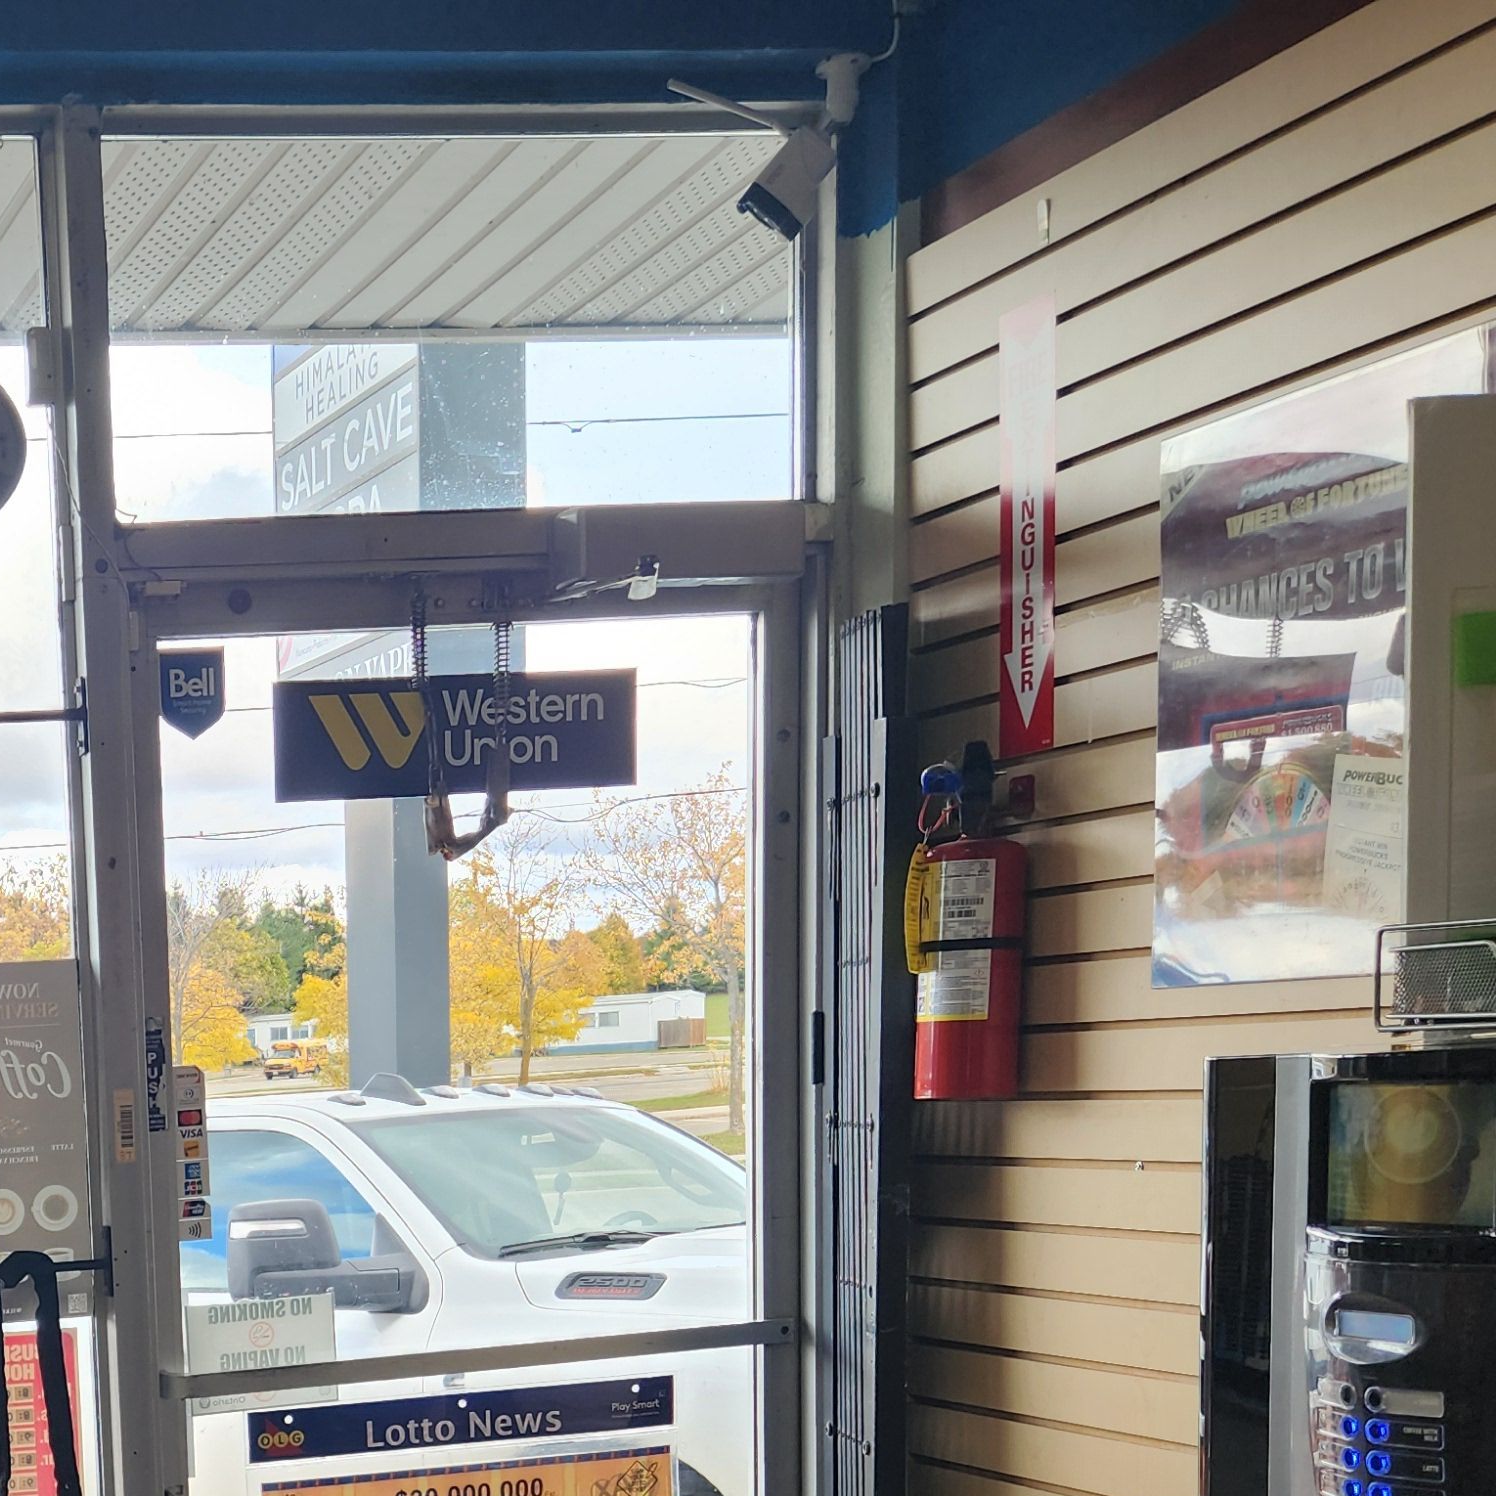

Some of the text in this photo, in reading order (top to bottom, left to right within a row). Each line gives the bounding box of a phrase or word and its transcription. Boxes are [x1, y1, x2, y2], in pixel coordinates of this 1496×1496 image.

[295, 344, 372, 401] HIMALA
[305, 351, 379, 424] HEALING
[281, 381, 414, 511] SALT CAVE
[1201, 542, 1385, 621] CHANCES TO
[168, 667, 215, 698] Bell
[442, 688, 604, 727] Western
[444, 731, 559, 767] Unon
[1342, 769, 1404, 786] POWERBUC
[179, 1128, 204, 1139] VISA
[611, 1398, 660, 1414] Play Smart
[258, 1430, 305, 1449] OLG
[365, 1409, 563, 1448] Lotto News
